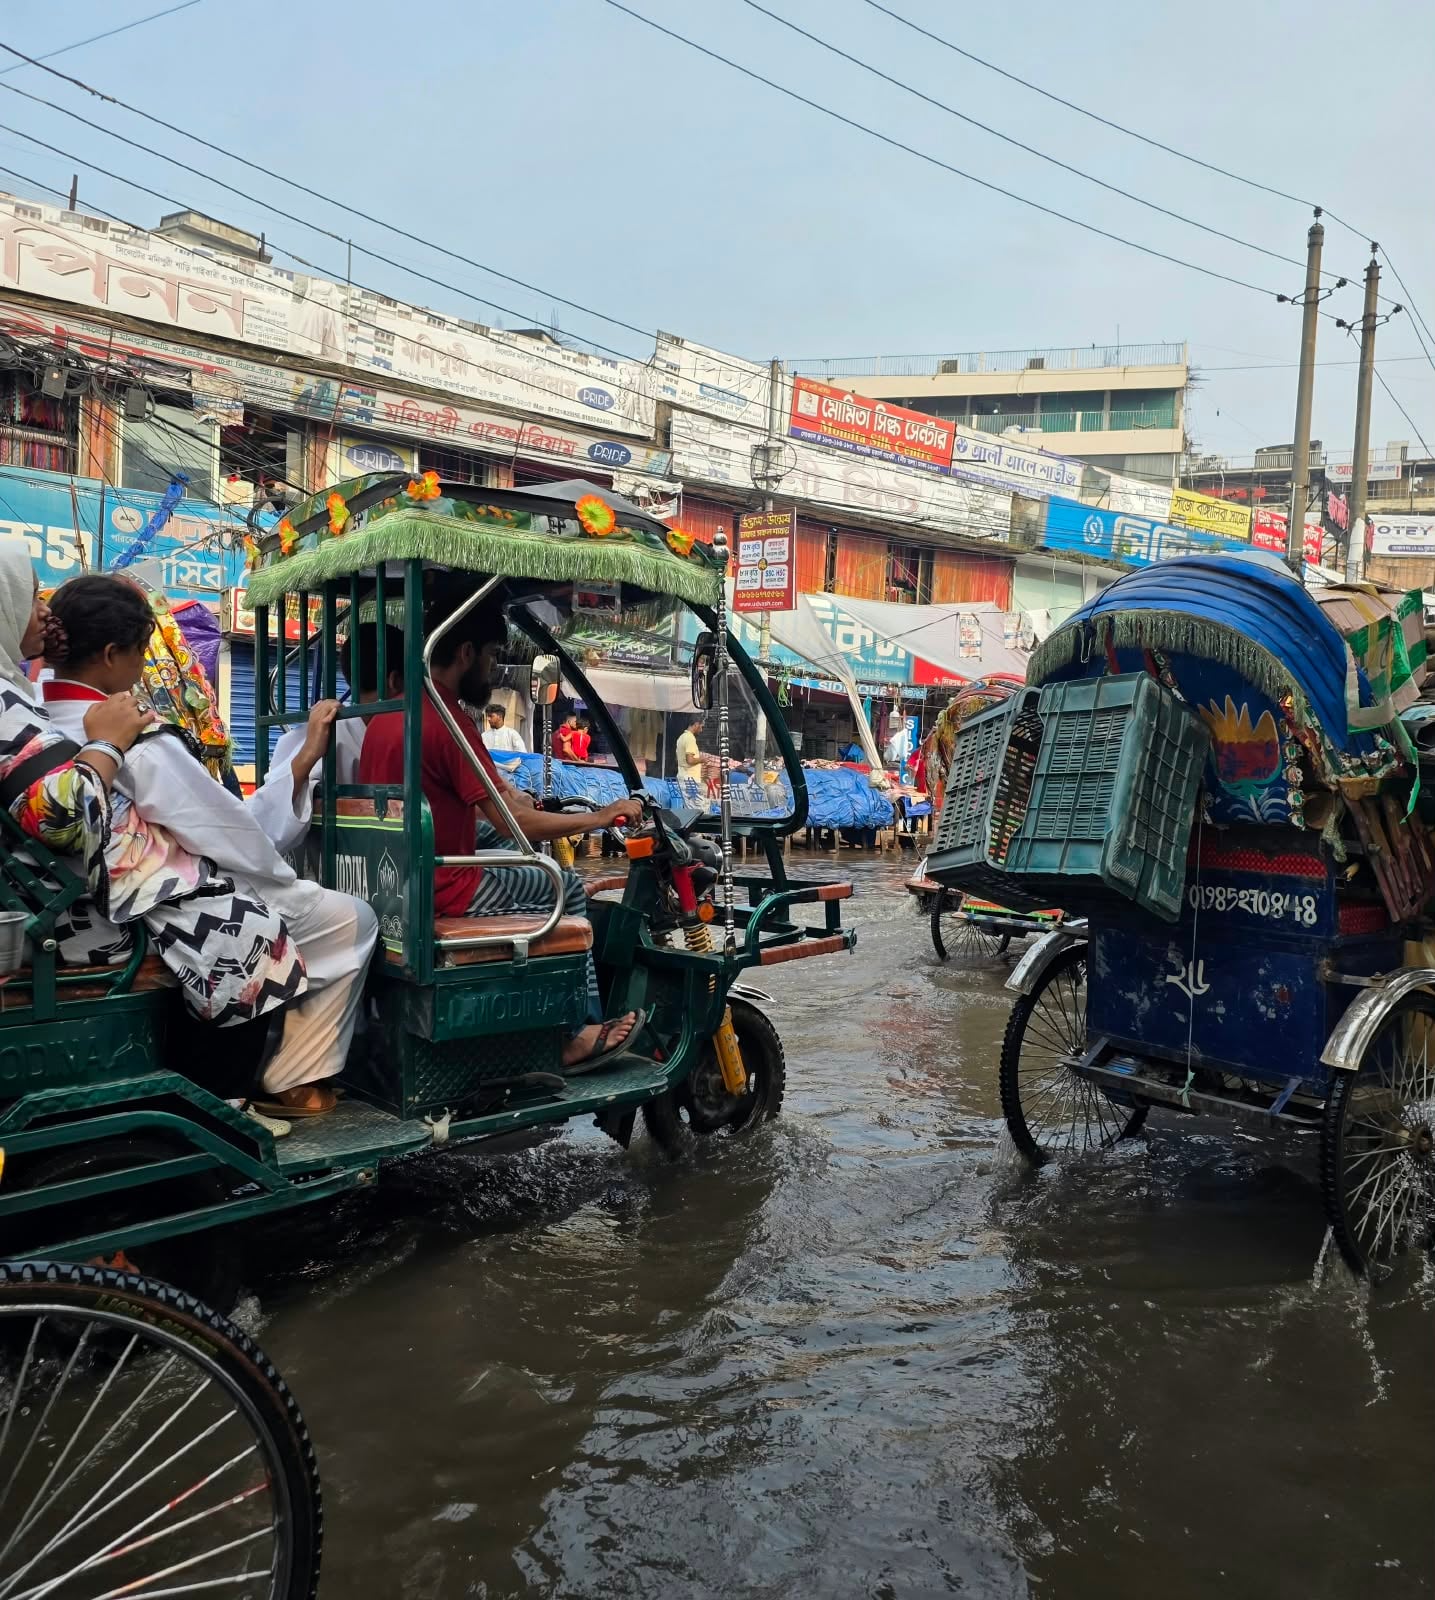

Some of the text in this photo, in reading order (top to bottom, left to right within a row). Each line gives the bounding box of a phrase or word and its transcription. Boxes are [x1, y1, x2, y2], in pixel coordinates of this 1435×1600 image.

[583, 389, 610, 407] PRIDE
[821, 394, 950, 450] মোমিতা সিল্ক সেন্টার
[819, 420, 933, 462] Momita Silk Centre
[349, 448, 401, 472] PRIDE
[593, 444, 627, 463] PRIDE
[1174, 495, 1195, 513] সাজো
[738, 600, 784, 608] www.udvash.com
[853, 663, 888, 679] House
